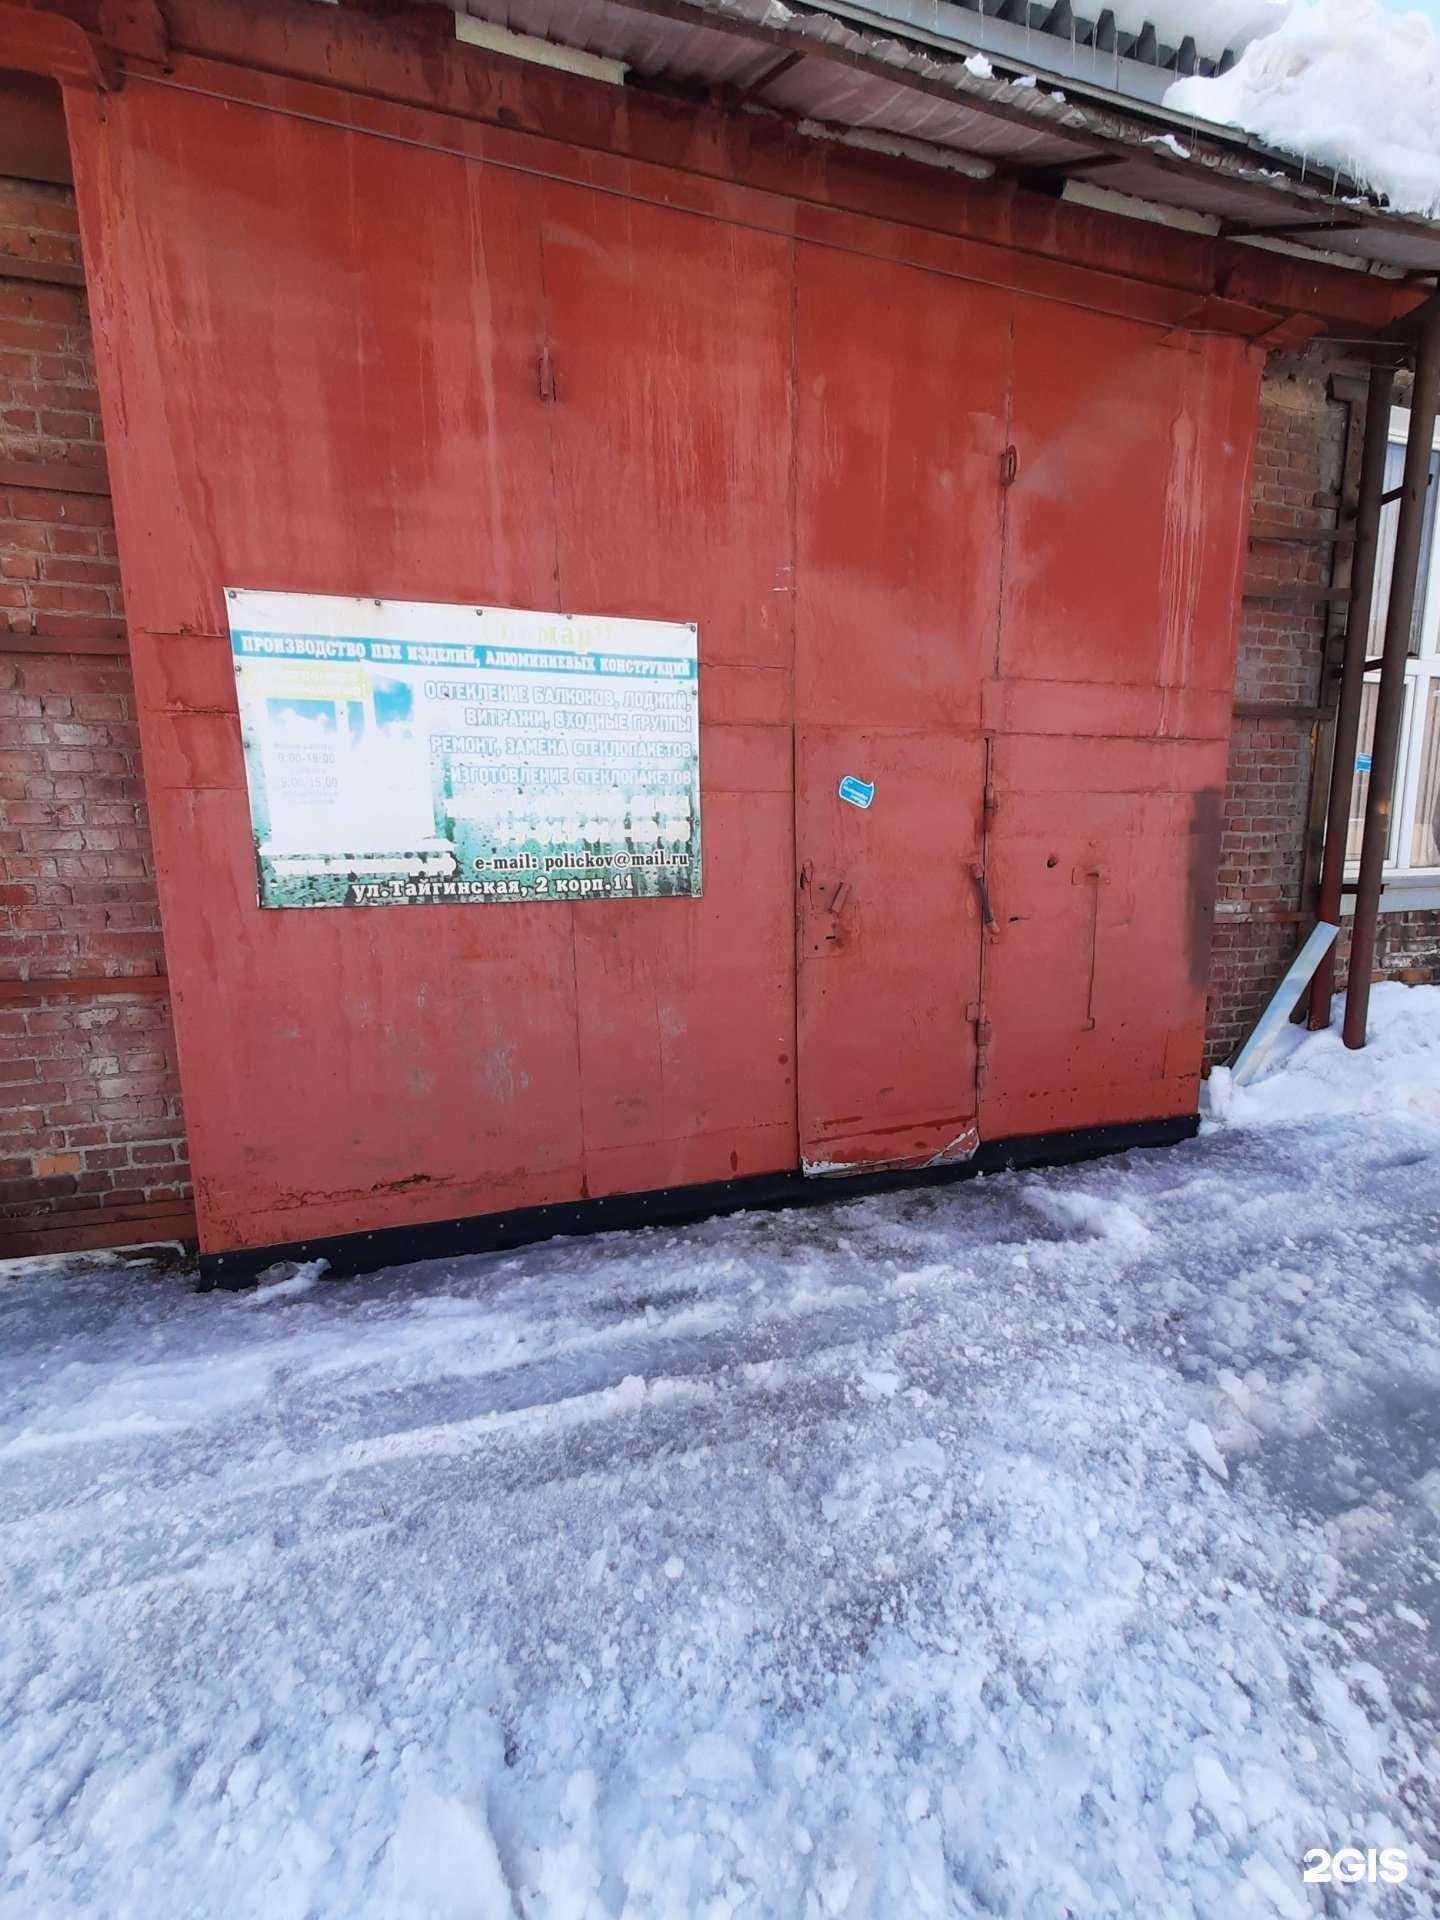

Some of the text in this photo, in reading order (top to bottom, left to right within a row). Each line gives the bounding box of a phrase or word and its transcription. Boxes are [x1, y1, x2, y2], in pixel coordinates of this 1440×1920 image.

[241, 635, 690, 678] ПРОИЗВОДСТВО ПВХ ИЗДЕЛИЙ, АЛЮМИНИЕВЫХ КОНСТРУКЦИЙ
[424, 681, 692, 713] ОСТЕКЛЕНИЕ БАЛКОНОВ, ЛОДЖИЙ,
[465, 708, 692, 733] ВИТРАЖИ, ВХОДНЫЕ ГРУППЫ
[430, 735, 693, 759] РЕМОНТ, ЗАМЕНА СТЕКЛОПАКЕТОВ
[451, 766, 693, 787] ИЗГОТОВЛЕНИЕ СТЕКЛОПАКЕТОВ
[474, 854, 538, 871] e-mail:
[543, 850, 690, 873] polickov@mail.ru
[351, 873, 635, 902] ул.Тайгинская, 2 корп.11
